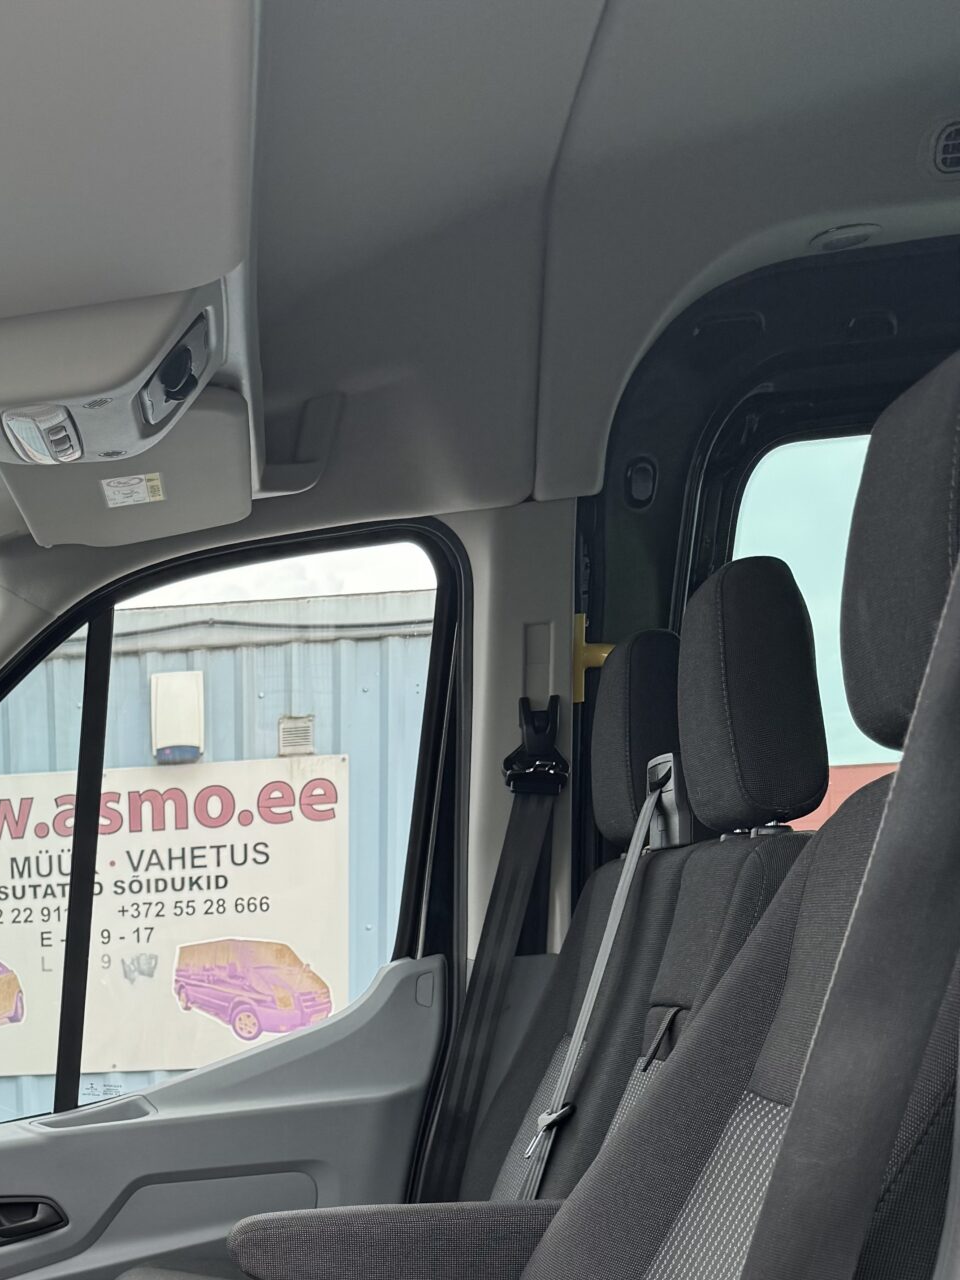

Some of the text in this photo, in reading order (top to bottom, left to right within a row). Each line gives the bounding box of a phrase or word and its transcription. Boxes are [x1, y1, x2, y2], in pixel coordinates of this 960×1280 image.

[10, 848, 100, 879] MÜÜ
[126, 842, 270, 873] VAHETUS
[113, 874, 229, 896] SÕIDUKID
[11, 907, 34, 924] 22
[40, 905, 68, 923] 91
[117, 901, 166, 919] +372
[173, 899, 196, 917] 55
[203, 898, 227, 915] 28
[234, 896, 270, 914] 666
[40, 931, 53, 947] E
[100, 928, 111, 945] 9
[132, 927, 155, 943] 17
[101, 953, 111, 969] 9
